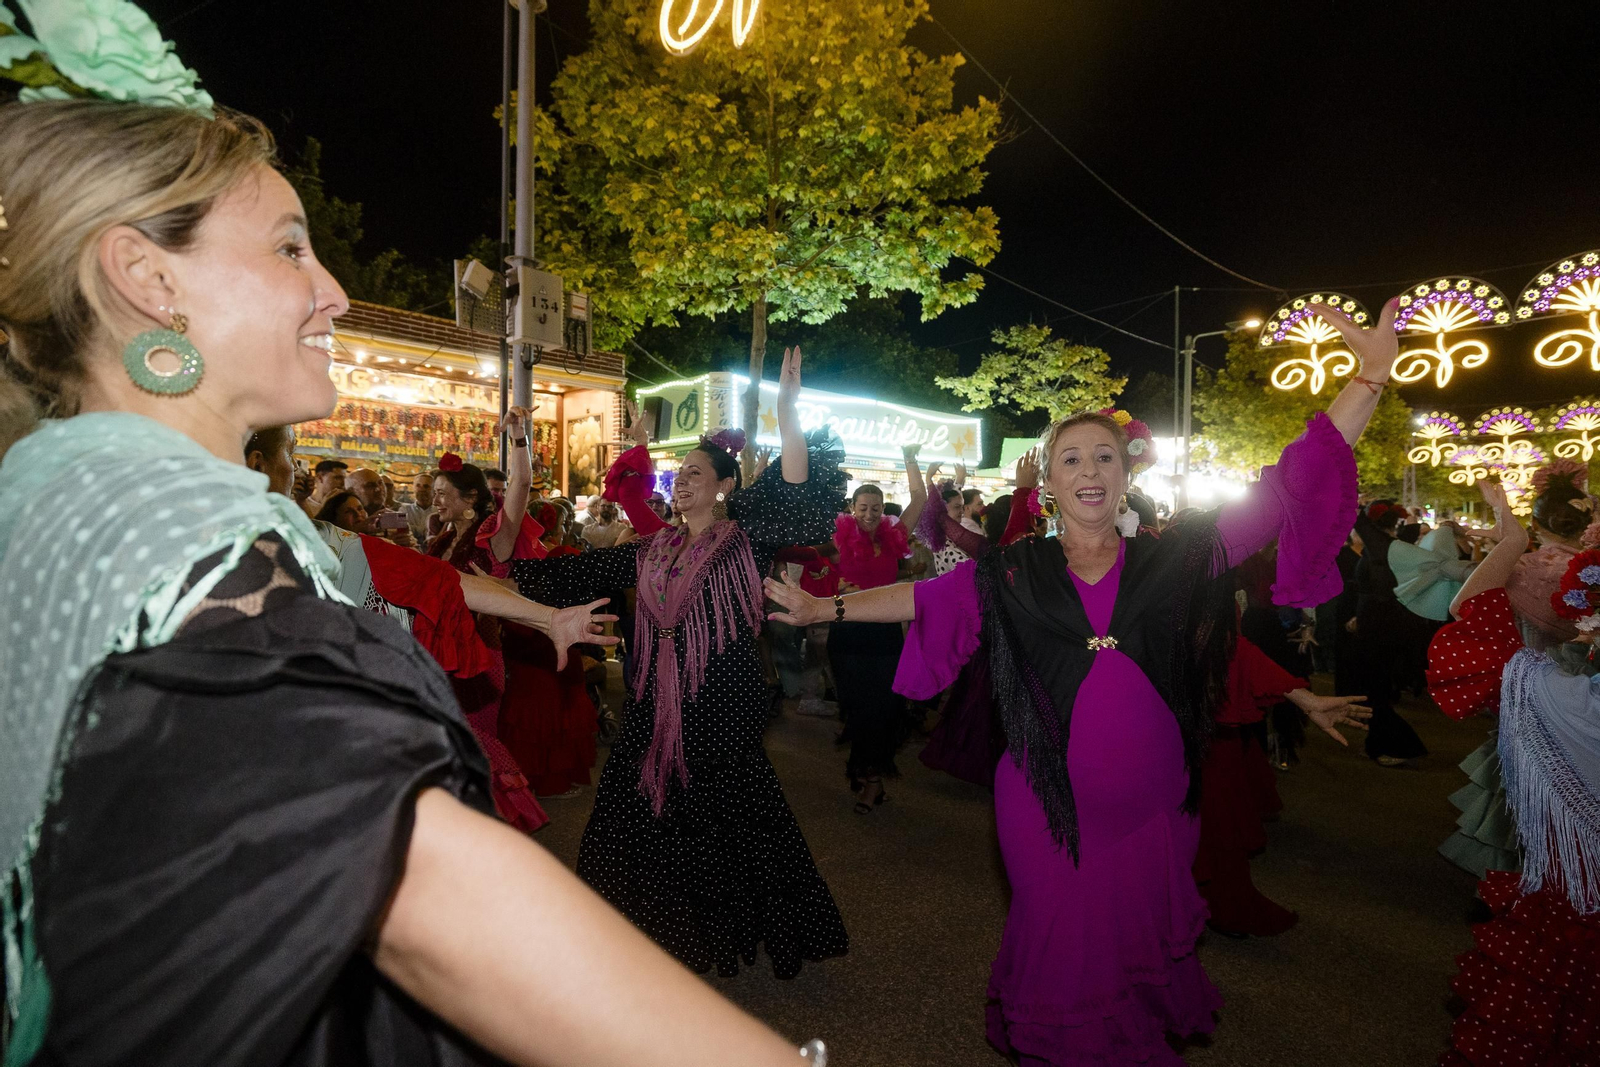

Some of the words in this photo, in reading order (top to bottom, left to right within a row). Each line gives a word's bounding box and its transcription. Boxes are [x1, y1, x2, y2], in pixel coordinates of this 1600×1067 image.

[532, 296, 558, 313] 134
[295, 437, 333, 448] OSCATEL
[341, 440, 379, 452] MÁLAGA
[386, 445, 429, 457] MOSCATEL
